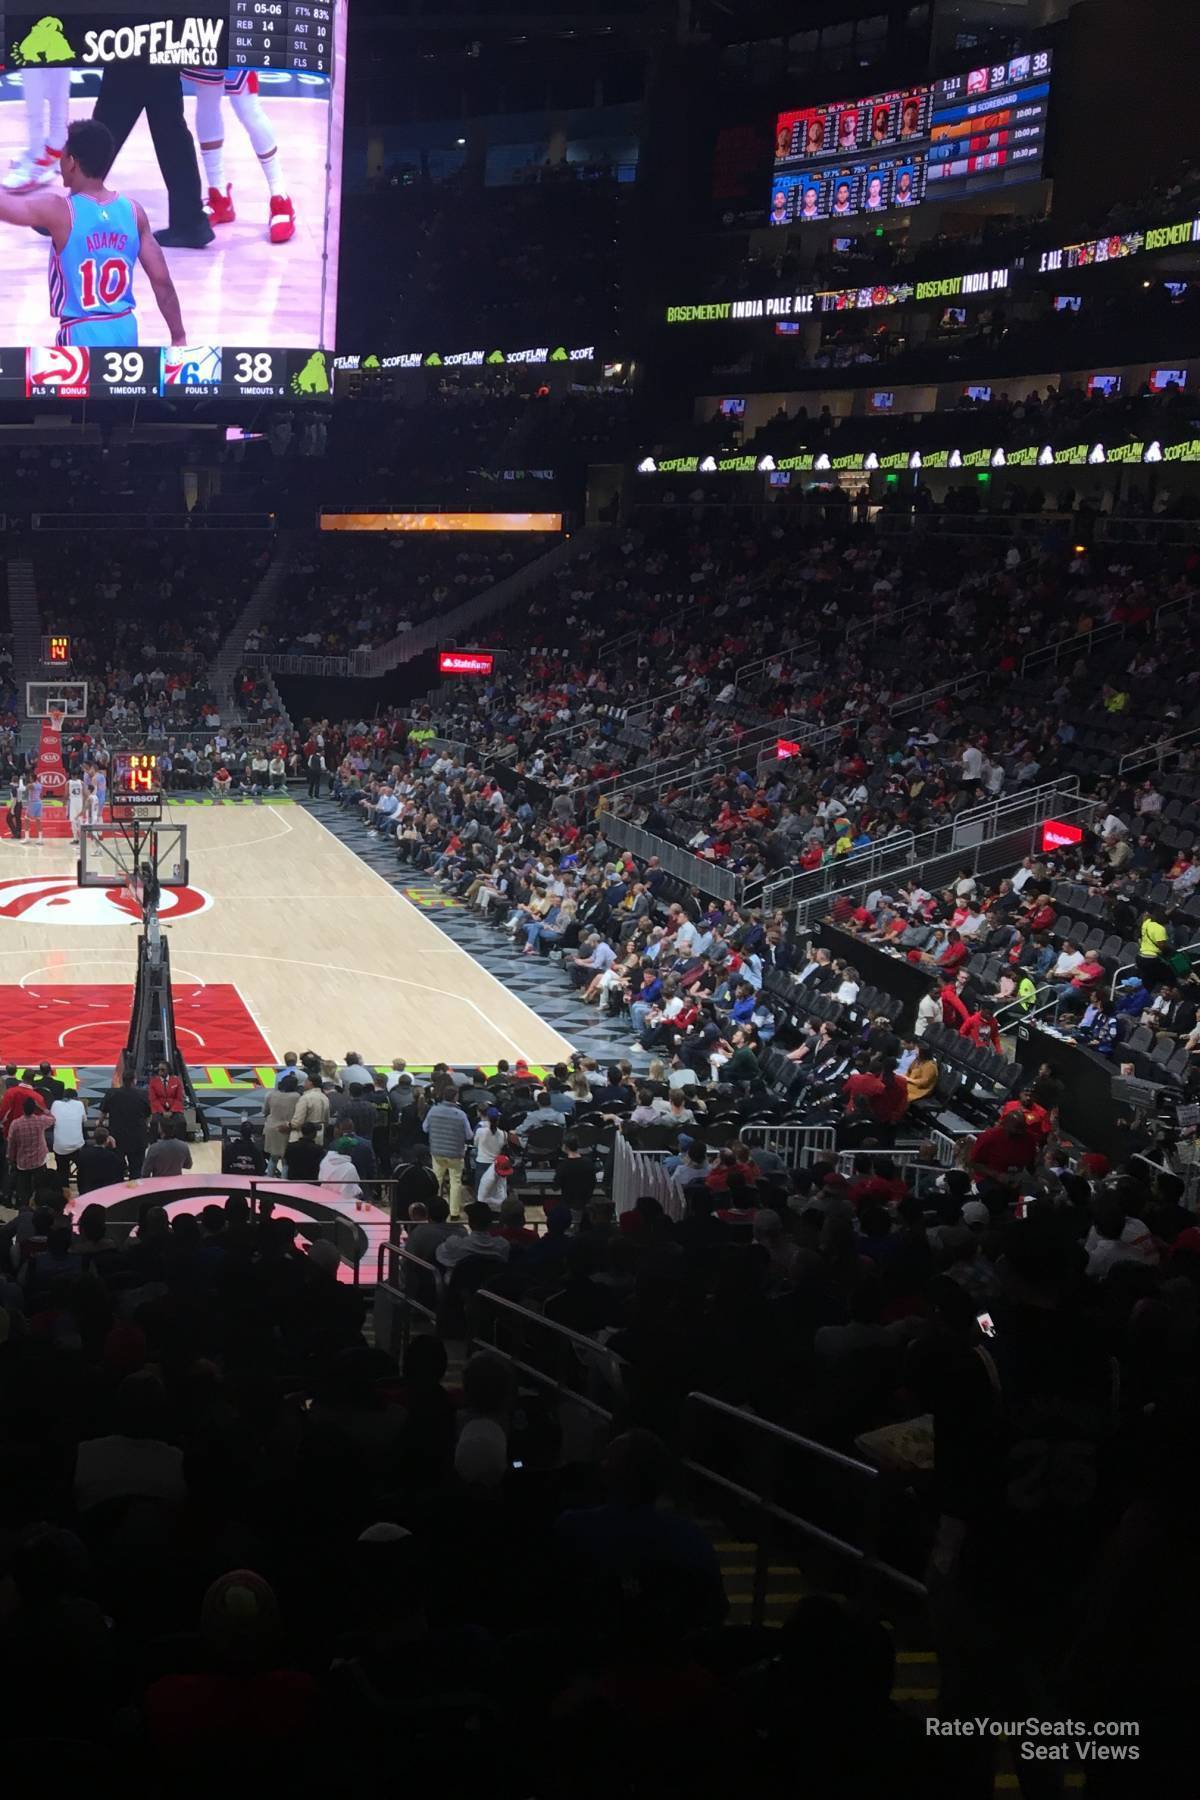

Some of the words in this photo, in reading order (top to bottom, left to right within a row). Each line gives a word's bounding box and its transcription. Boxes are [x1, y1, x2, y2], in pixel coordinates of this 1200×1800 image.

[237, 3, 246, 12] FT
[254, 3, 282, 15] 05-06
[295, 7, 311, 17] FT%
[313, 8, 329, 21] 83%
[236, 20, 253, 29] REB
[262, 21, 274, 31] 14
[294, 24, 309, 34] AST
[317, 26, 326, 37] 10
[82, 17, 224, 63] SCOFFLAW
[236, 37, 253, 47] BLK
[264, 38, 271, 48] 0
[294, 41, 308, 51] STL
[318, 43, 324, 54] 0
[149, 48, 200, 65] BREWING
[201, 48, 218, 66] CO
[235, 54, 246, 64] TO
[263, 55, 270, 66] 2
[1032, 53, 1048, 71] 38
[293, 58, 307, 68] FLS
[317, 60, 323, 71] 5
[990, 66, 1005, 83] 39
[942, 78, 961, 91] 1:11
[978, 94, 1018, 113] SCOREBOARD
[85, 232, 127, 252] ADAMS
[1145, 222, 1192, 250] BASEMENT
[1048, 249, 1062, 270] ALE
[79, 257, 129, 309] 10
[916, 277, 962, 300] BASEMENT
[962, 272, 989, 294] INDIA
[732, 299, 763, 318] INDIA
[766, 297, 791, 315] PALE
[794, 294, 814, 313] ALE
[382, 353, 422, 367] SCOFFLAW
[444, 351, 484, 366] SCOFFLAW
[507, 348, 548, 363] SCOFFLAW
[102, 351, 144, 383] 39
[233, 352, 272, 383] 38
[32, 387, 46, 395] FLS
[50, 386, 55, 395] 4
[60, 386, 87, 395] BONUS
[109, 386, 146, 395] TIMEOUTS
[152, 386, 158, 395] 6
[185, 386, 208, 395] FOULS
[213, 386, 219, 395] 5
[239, 387, 274, 395] TIMEOUTS
[279, 387, 284, 395] 6
[658, 457, 699, 471] SCOFFLAW
[718, 456, 757, 470] SCOFFLAW
[777, 454, 814, 470] SCOFFLAW
[51, 646, 65, 659] 14
[40, 775, 61, 784] KIA
[130, 769, 152, 791] 14
[72, 787, 80, 796] 43
[128, 795, 158, 803] TISSOT
